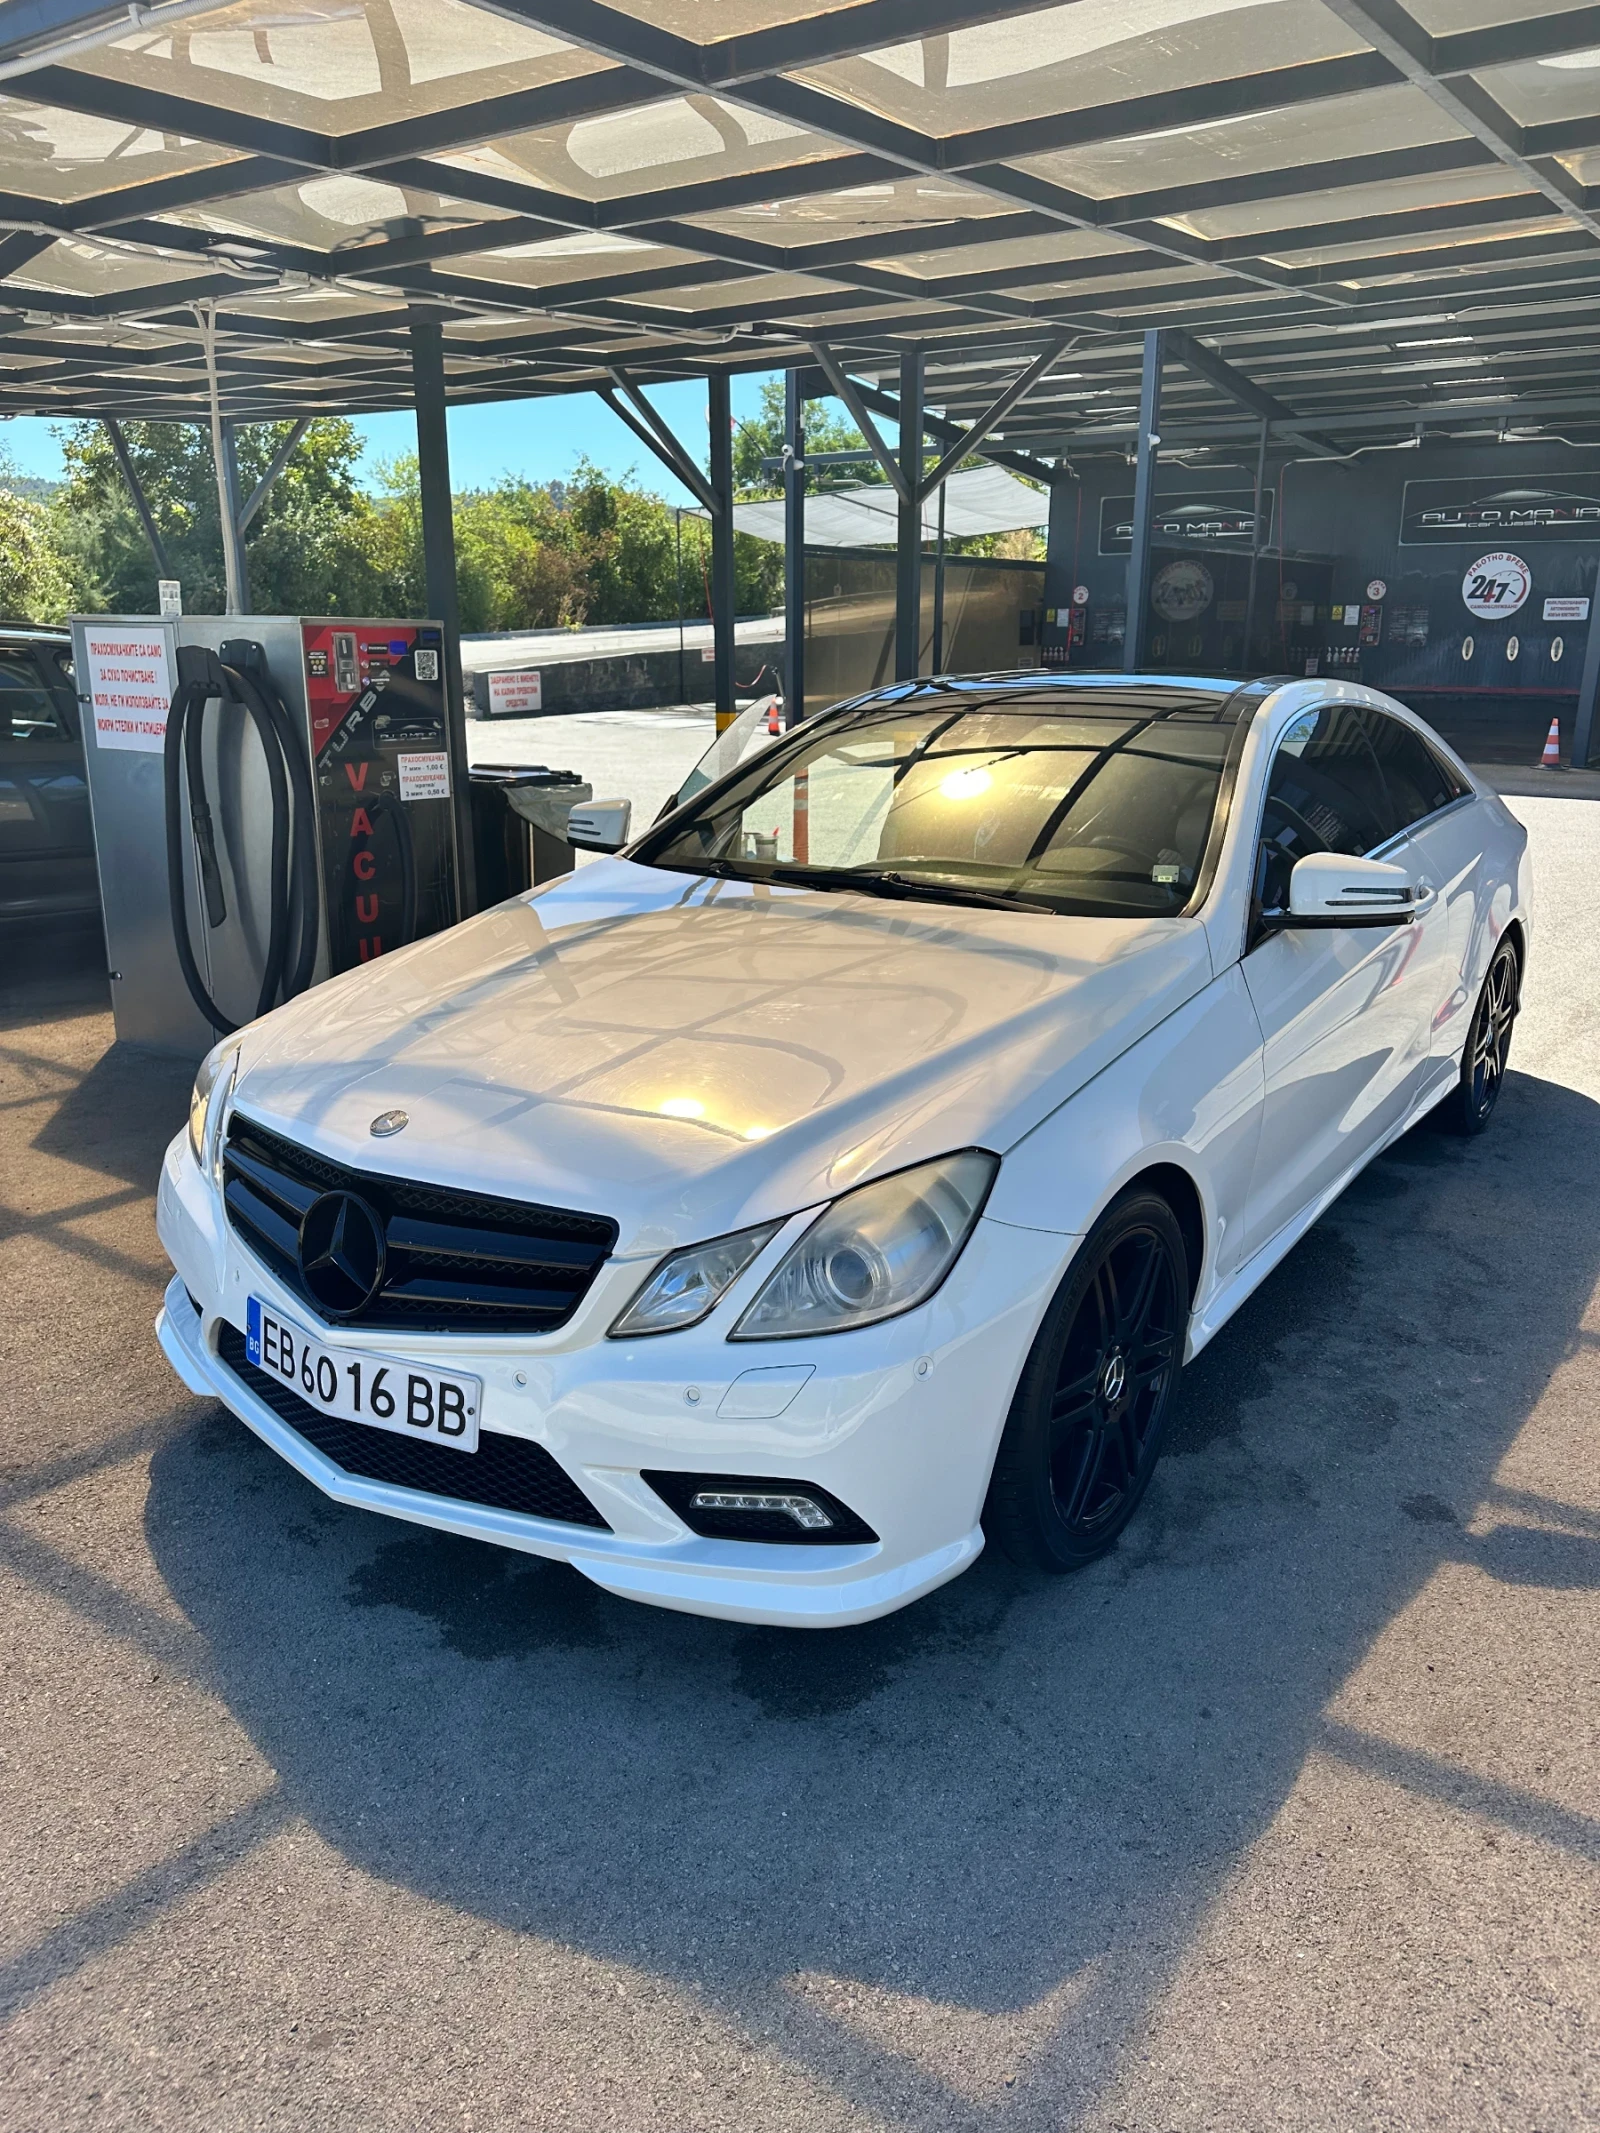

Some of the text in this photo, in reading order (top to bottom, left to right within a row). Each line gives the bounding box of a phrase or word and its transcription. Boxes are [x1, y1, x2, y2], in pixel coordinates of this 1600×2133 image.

[1421, 507, 1600, 523] AUTO MANIA
[1499, 519, 1546, 527] wash
[1116, 524, 1180, 535] ATO
[1467, 554, 1529, 577] РАБОТНО ВРЕМЕ
[1078, 592, 1083, 600] 2
[1372, 587, 1380, 596] 3
[90, 642, 162, 658] ПРАХОСМУКАЧКИТЕ СА САМО
[100, 668, 107, 681] ЗА
[107, 669, 120, 681] СУХО
[120, 669, 155, 684] ПОЧИСТВАНЕ
[110, 694, 118, 707] НЕ
[118, 695, 125, 707] ГИ
[162, 697, 169, 710] ЗА
[97, 718, 167, 735] МОКРИ СТЕЛКИ И ТАПИЦЕРИ
[401, 755, 445, 763] ПРАХОСМУКАЧКА
[402, 774, 446, 783] ПРАХОСМУКАЧКА
[344, 762, 382, 963] VACUU
[249, 1336, 260, 1355] BG
[264, 1315, 296, 1380] EB
[407, 1374, 466, 1437] BB
